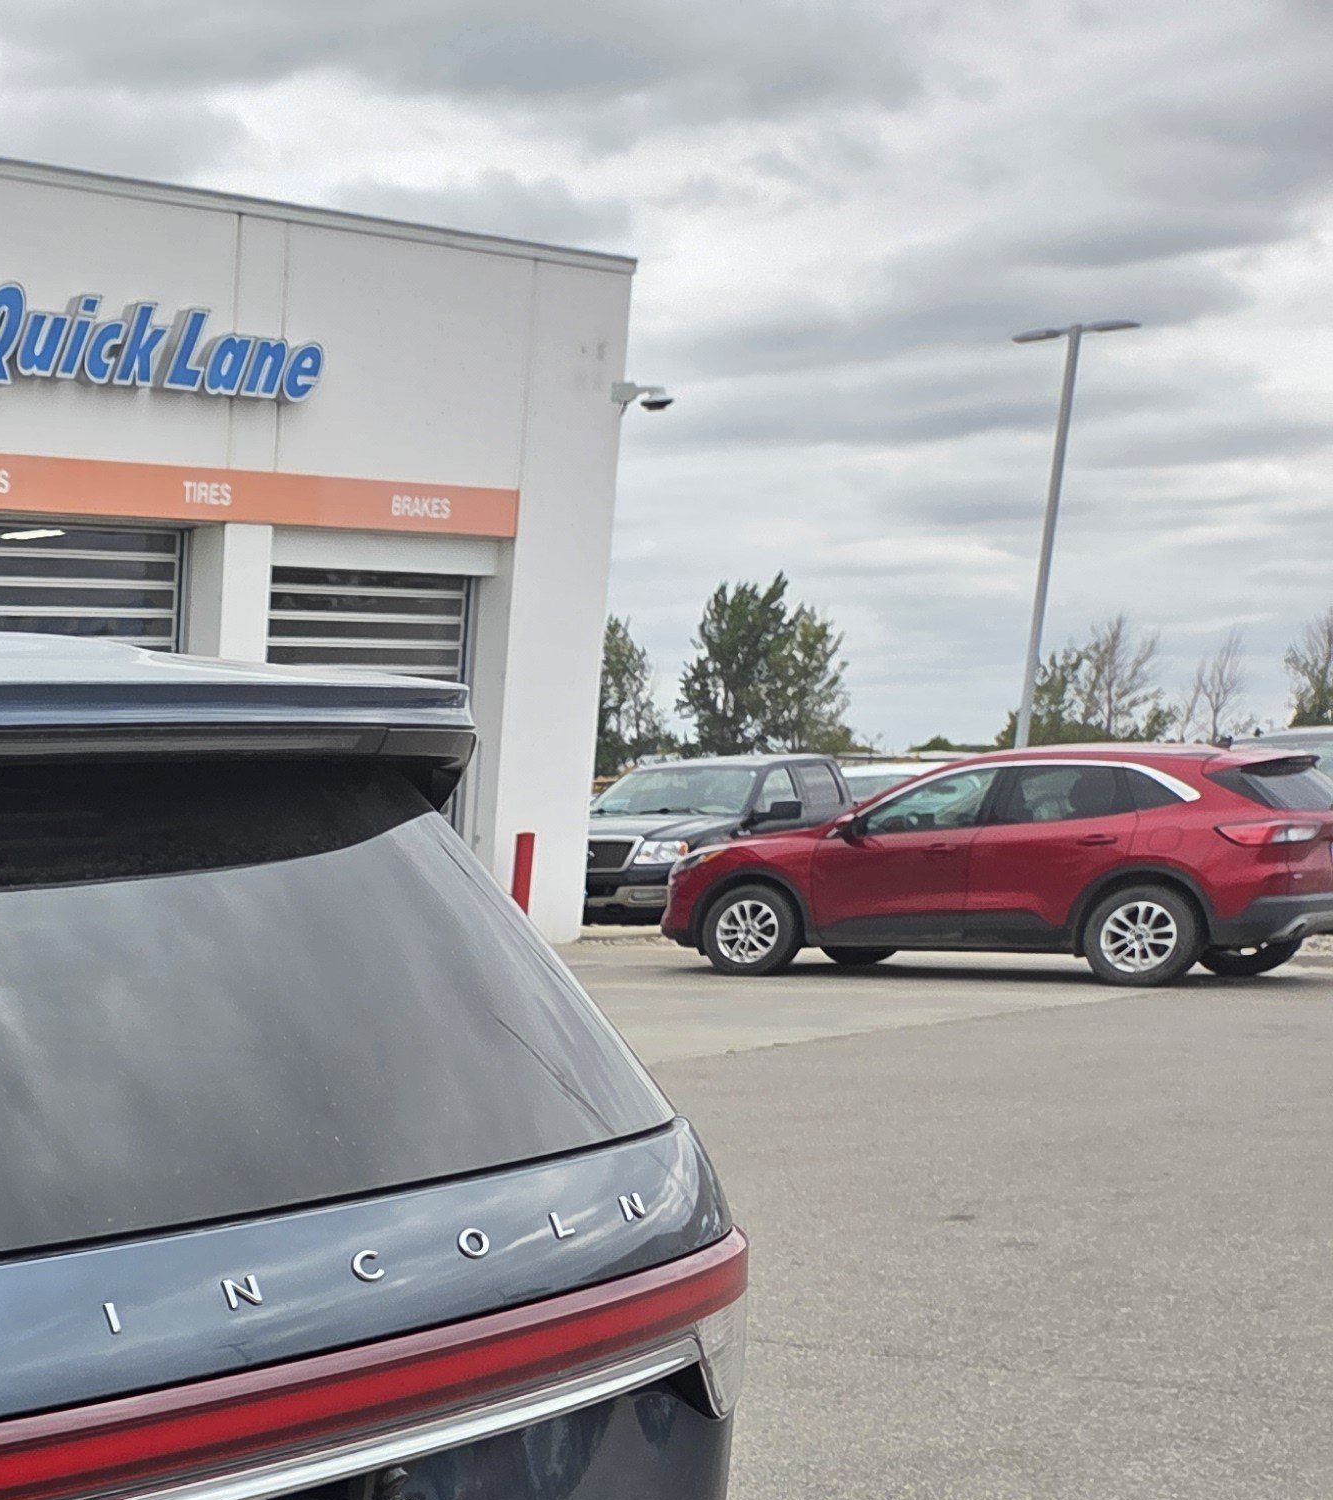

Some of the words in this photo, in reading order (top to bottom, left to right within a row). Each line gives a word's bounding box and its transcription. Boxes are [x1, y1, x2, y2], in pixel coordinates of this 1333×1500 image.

[163, 308, 325, 403] Lane
[182, 480, 232, 506] TIRES
[391, 494, 451, 519] BRAKES
